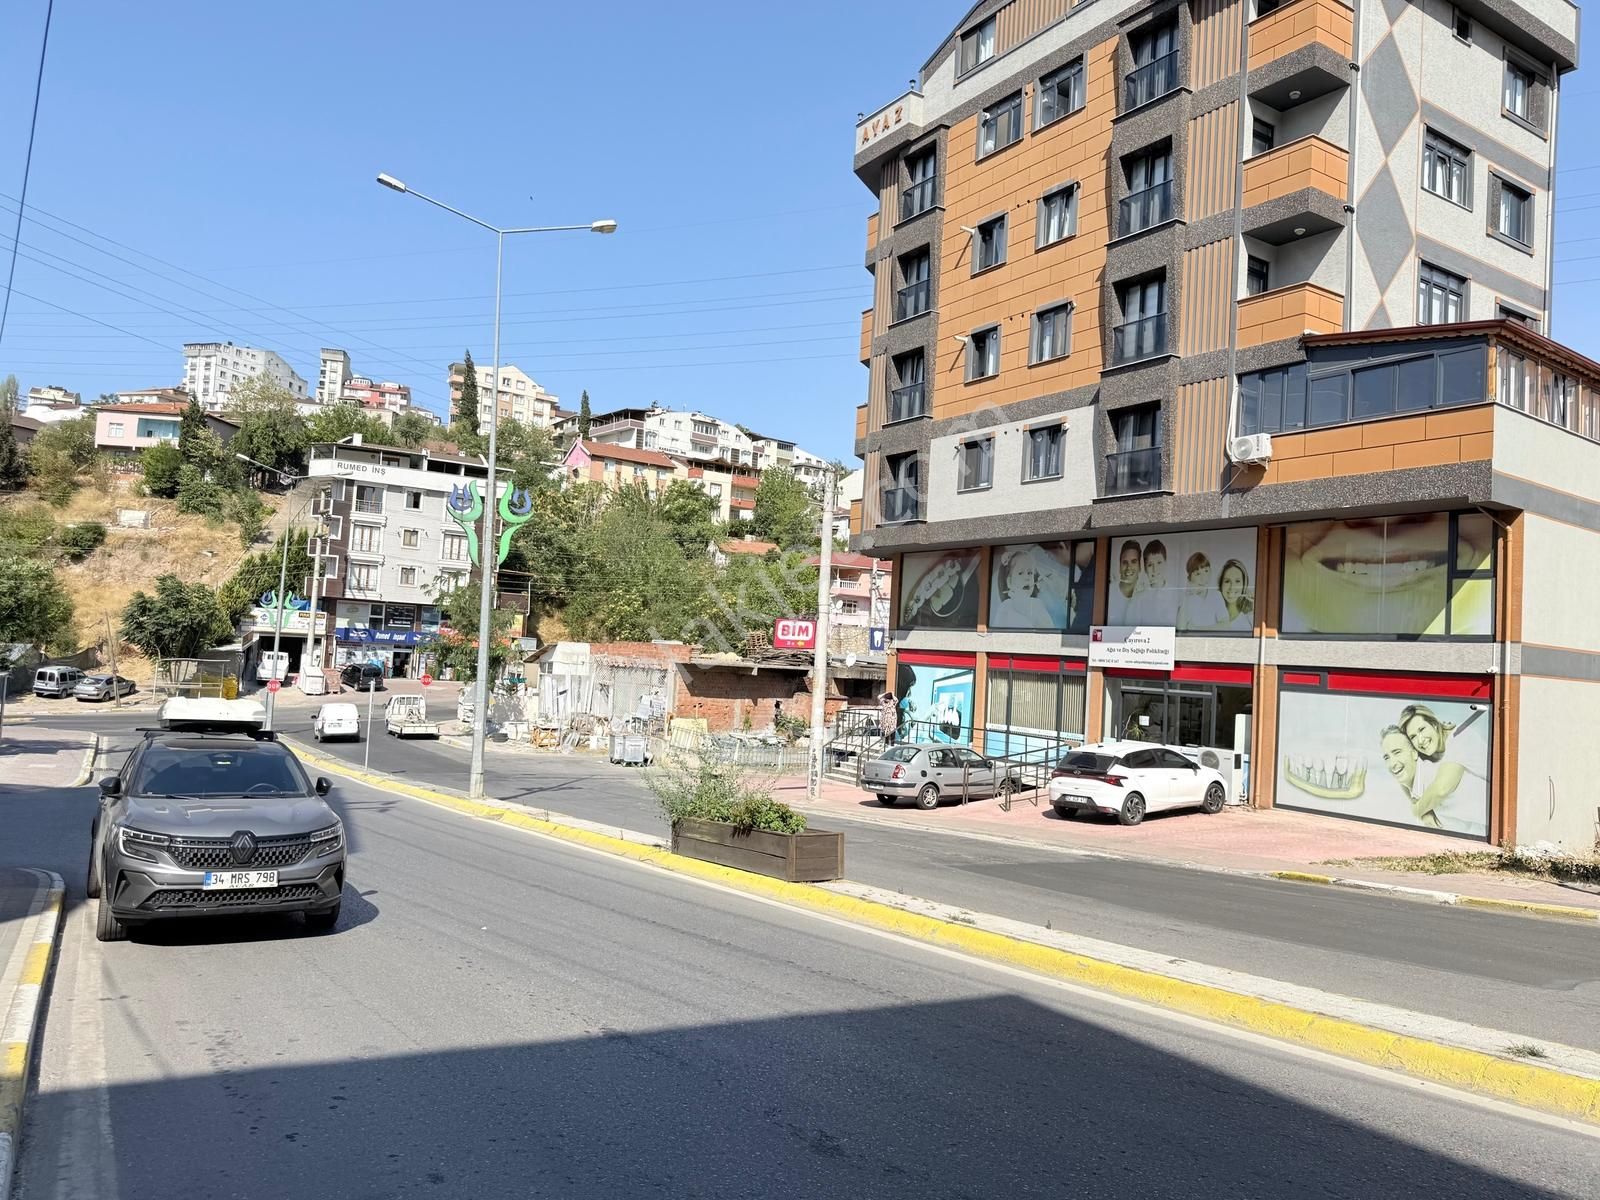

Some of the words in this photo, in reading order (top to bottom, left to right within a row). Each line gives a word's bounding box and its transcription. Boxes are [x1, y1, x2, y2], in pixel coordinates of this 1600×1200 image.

[862, 106, 902, 145] AYAZ
[337, 462, 368, 472] RUMED
[781, 623, 809, 637] BİM
[212, 874, 224, 885] 34
[231, 873, 250, 884] MRS
[256, 872, 275, 883] 798
